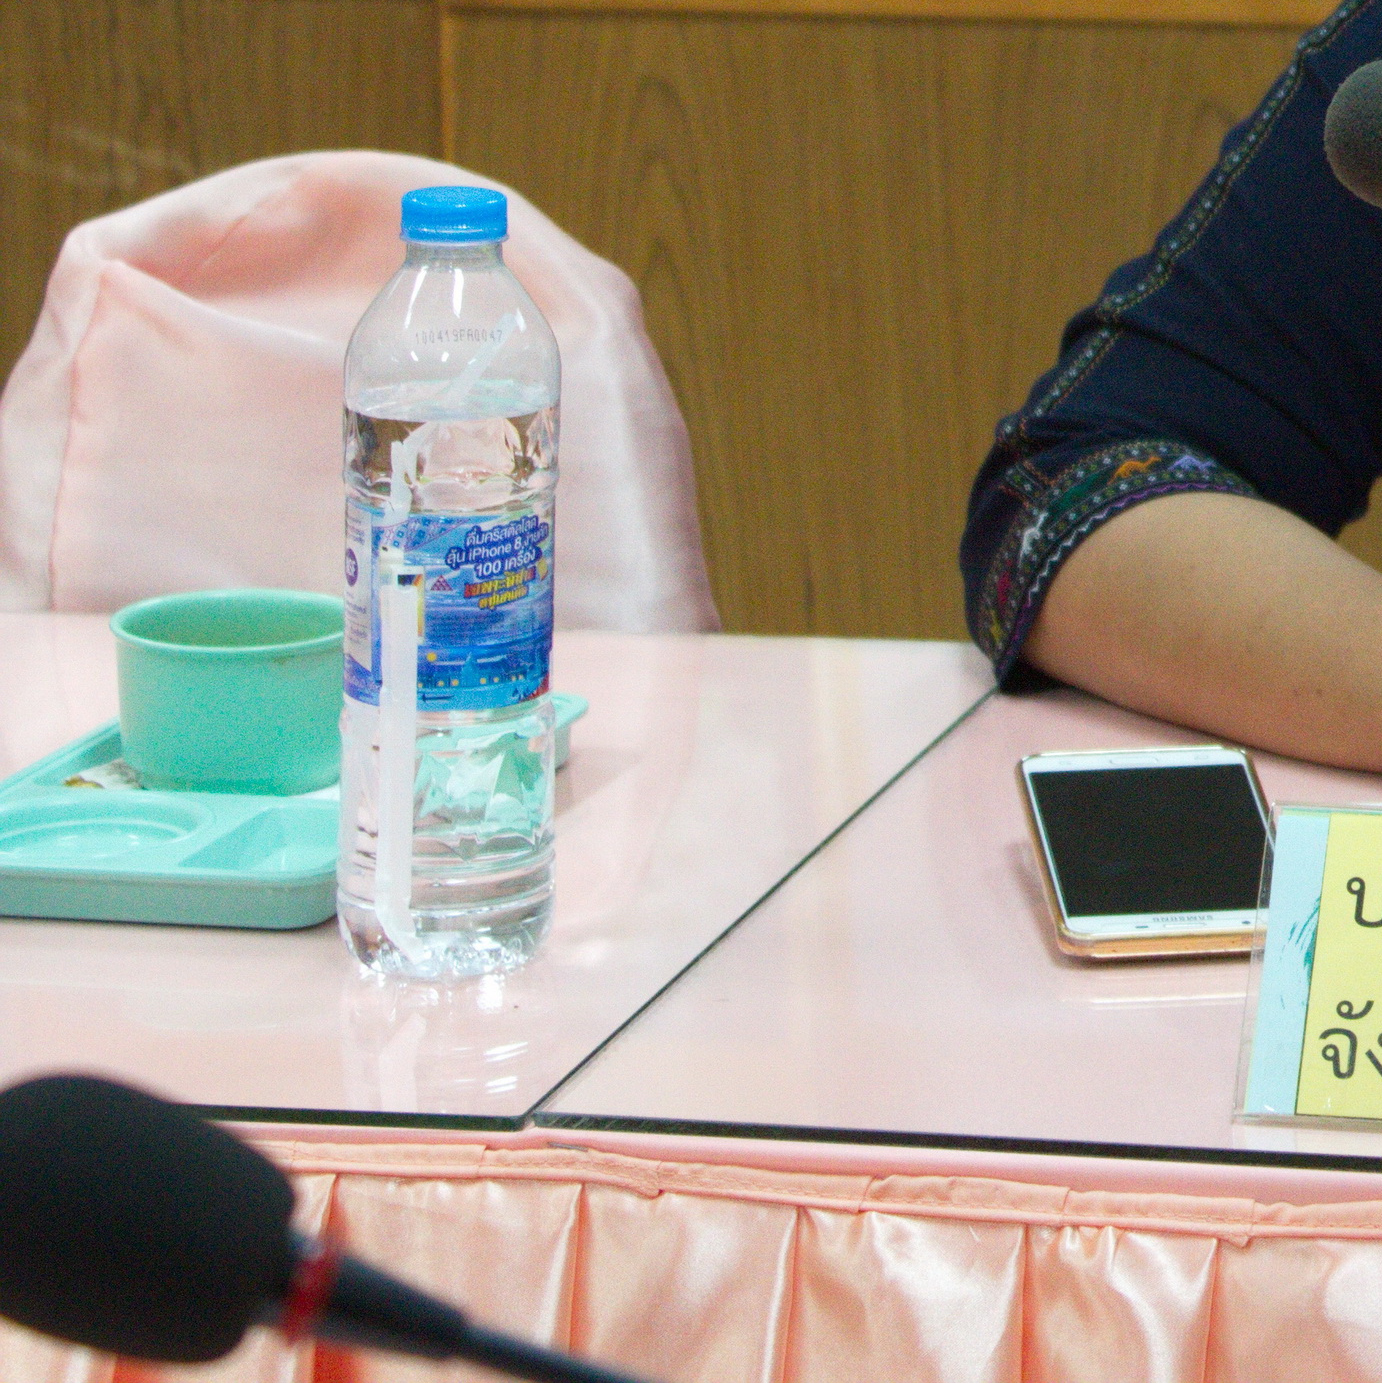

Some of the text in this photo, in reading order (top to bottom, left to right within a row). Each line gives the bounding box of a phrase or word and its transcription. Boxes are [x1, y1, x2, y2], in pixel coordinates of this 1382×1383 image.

[469, 543, 512, 561] iPhone
[514, 537, 523, 550] 8
[476, 561, 502, 577] 100
